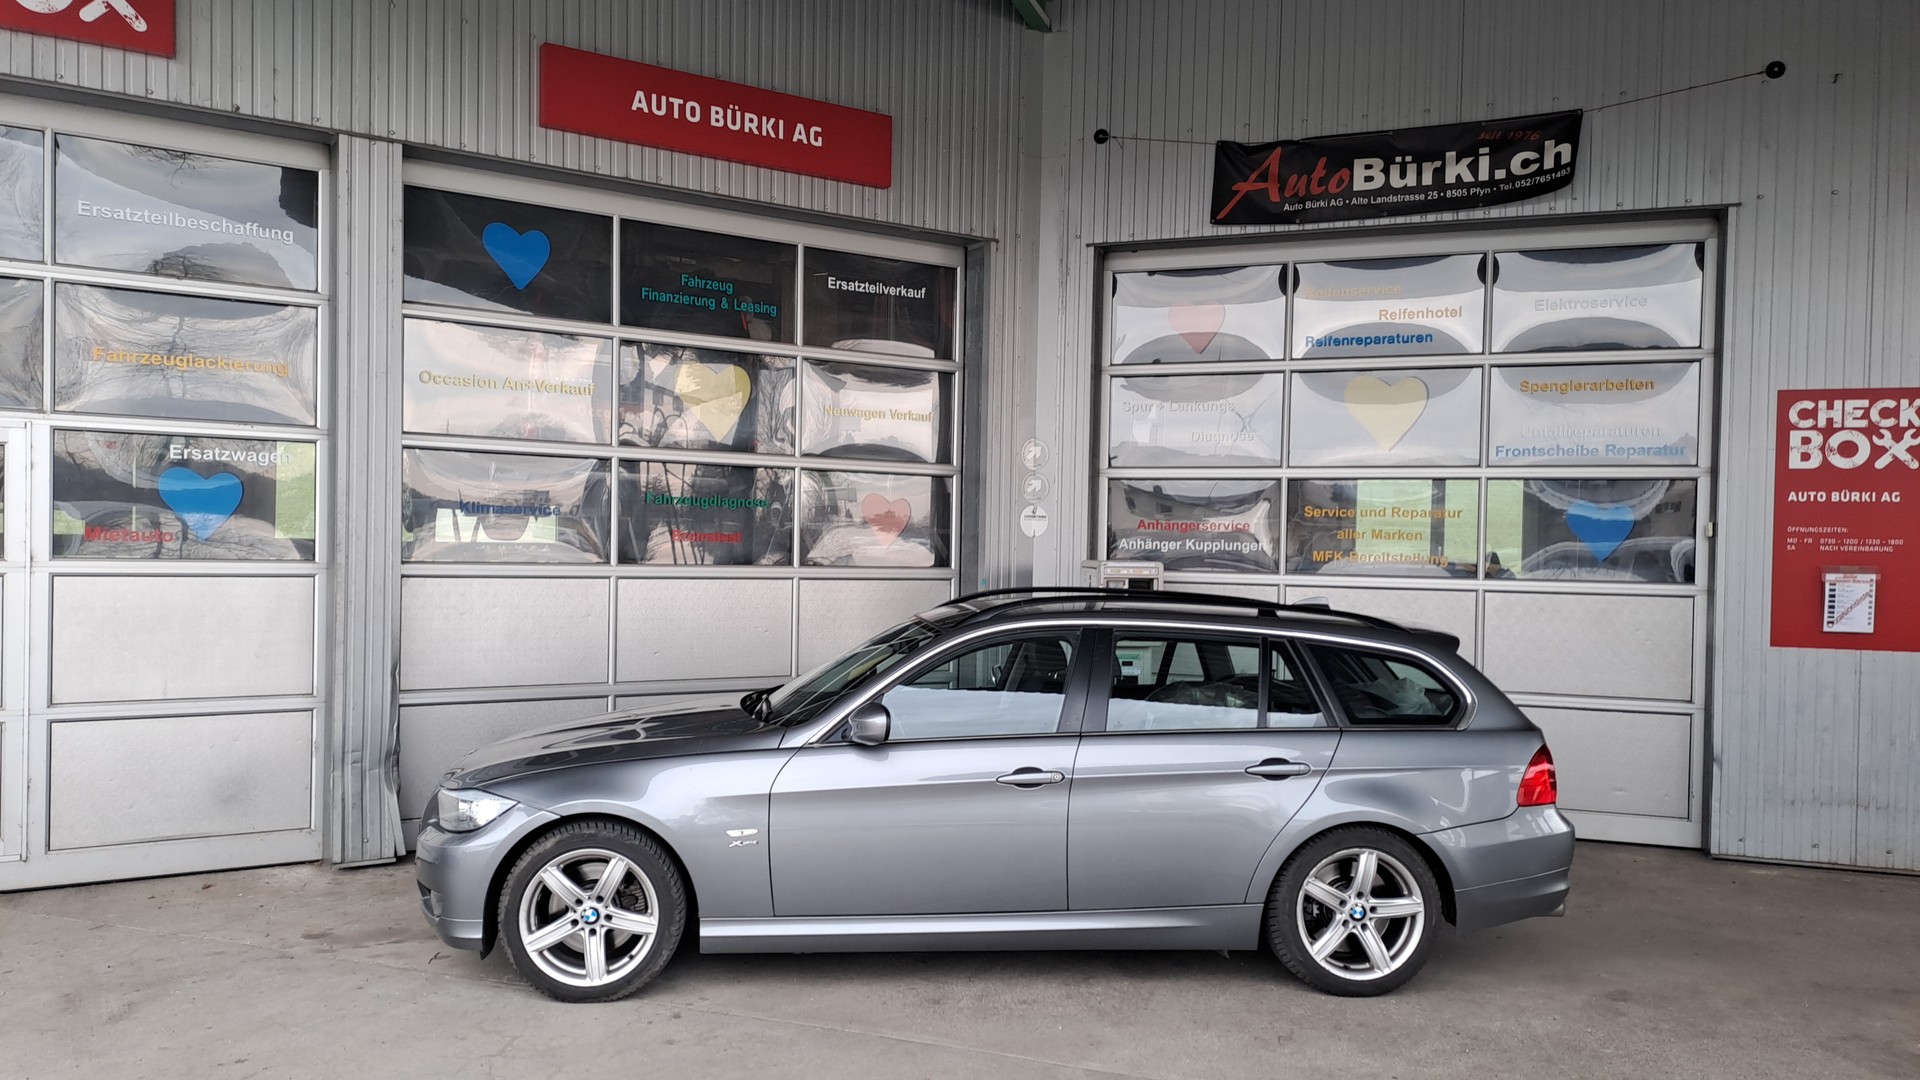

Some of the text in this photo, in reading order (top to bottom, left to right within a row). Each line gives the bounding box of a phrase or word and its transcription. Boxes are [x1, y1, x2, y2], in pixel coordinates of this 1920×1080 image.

[631, 90, 823, 147] AUTO BÜRKI AG
[1283, 203, 1304, 212] Auto
[1305, 200, 1328, 210] Bürki
[1330, 199, 1344, 207] AG
[1351, 198, 1369, 206] Alte
[1370, 192, 1425, 204] Landstrasse
[1427, 191, 1438, 200] 25
[1446, 188, 1468, 198] 8505
[1470, 186, 1491, 197] Pfyn
[77, 200, 295, 245] Ersatzteilbeschaffung
[681, 274, 733, 295] Fahrzeug
[827, 276, 926, 299] Ersatzteilverkauf
[641, 287, 777, 317] Finanzierung & Leasing
[1534, 296, 1648, 312] Elektroservice
[1378, 306, 1463, 321] Reifenhotel
[1304, 332, 1433, 348] Reifenreparaturen
[92, 346, 289, 377] Fahrzeuglackierung
[418, 369, 497, 390] Occasion
[1519, 379, 1656, 395] Spenglerarbeiten
[824, 403, 932, 423] Neuwagen Verkauf
[1122, 401, 1154, 413] Spur
[1169, 401, 1235, 413] Lenkungs
[1788, 398, 1920, 429] CHECK
[1190, 431, 1255, 442] Diagnose
[169, 444, 292, 464] Ersatzwagen
[1495, 443, 1688, 459] Frontscheibe Reparatur
[646, 491, 769, 510] Fahrzeugdiagnose
[1788, 489, 1901, 502] AUTO BÜRKI AG
[459, 499, 561, 517] Klimaservice
[1304, 506, 1463, 521] Service und Reparatur
[84, 525, 174, 543] Mietauto
[1136, 519, 1251, 534] Anhängerservice
[1336, 528, 1423, 541] aller Marken
[1119, 538, 1266, 554] Anhänger Kupplungen
